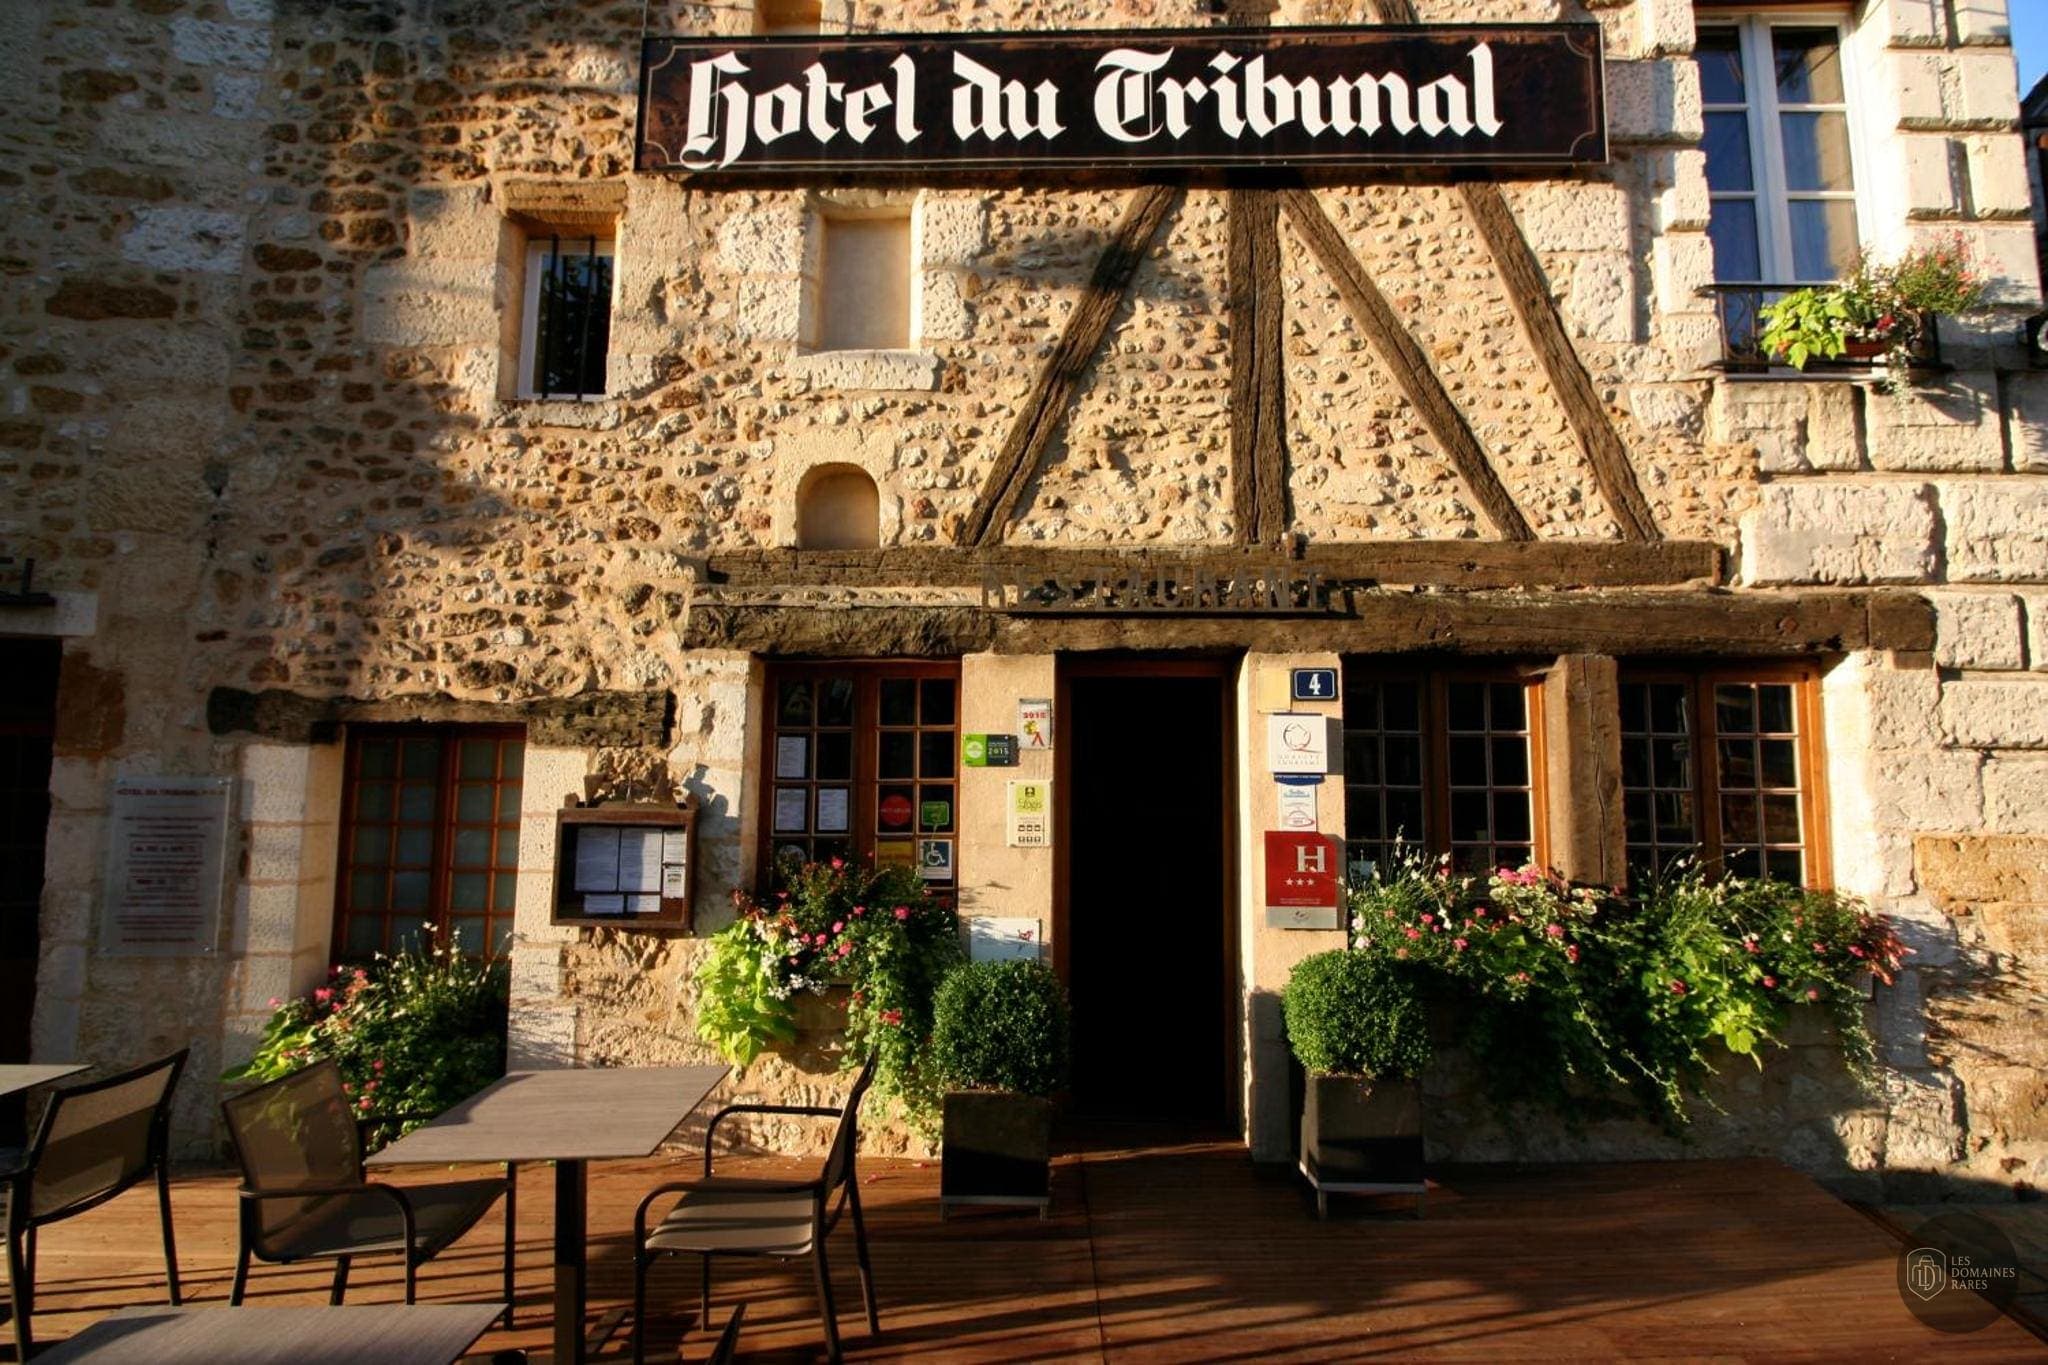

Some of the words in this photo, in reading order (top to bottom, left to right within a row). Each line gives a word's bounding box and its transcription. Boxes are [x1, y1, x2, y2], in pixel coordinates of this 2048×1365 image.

[679, 50, 923, 171] Hotel
[952, 50, 1067, 142] du
[1093, 41, 1504, 144] Tribunal
[1308, 674, 1322, 695] 4
[1294, 845, 1327, 873] H
